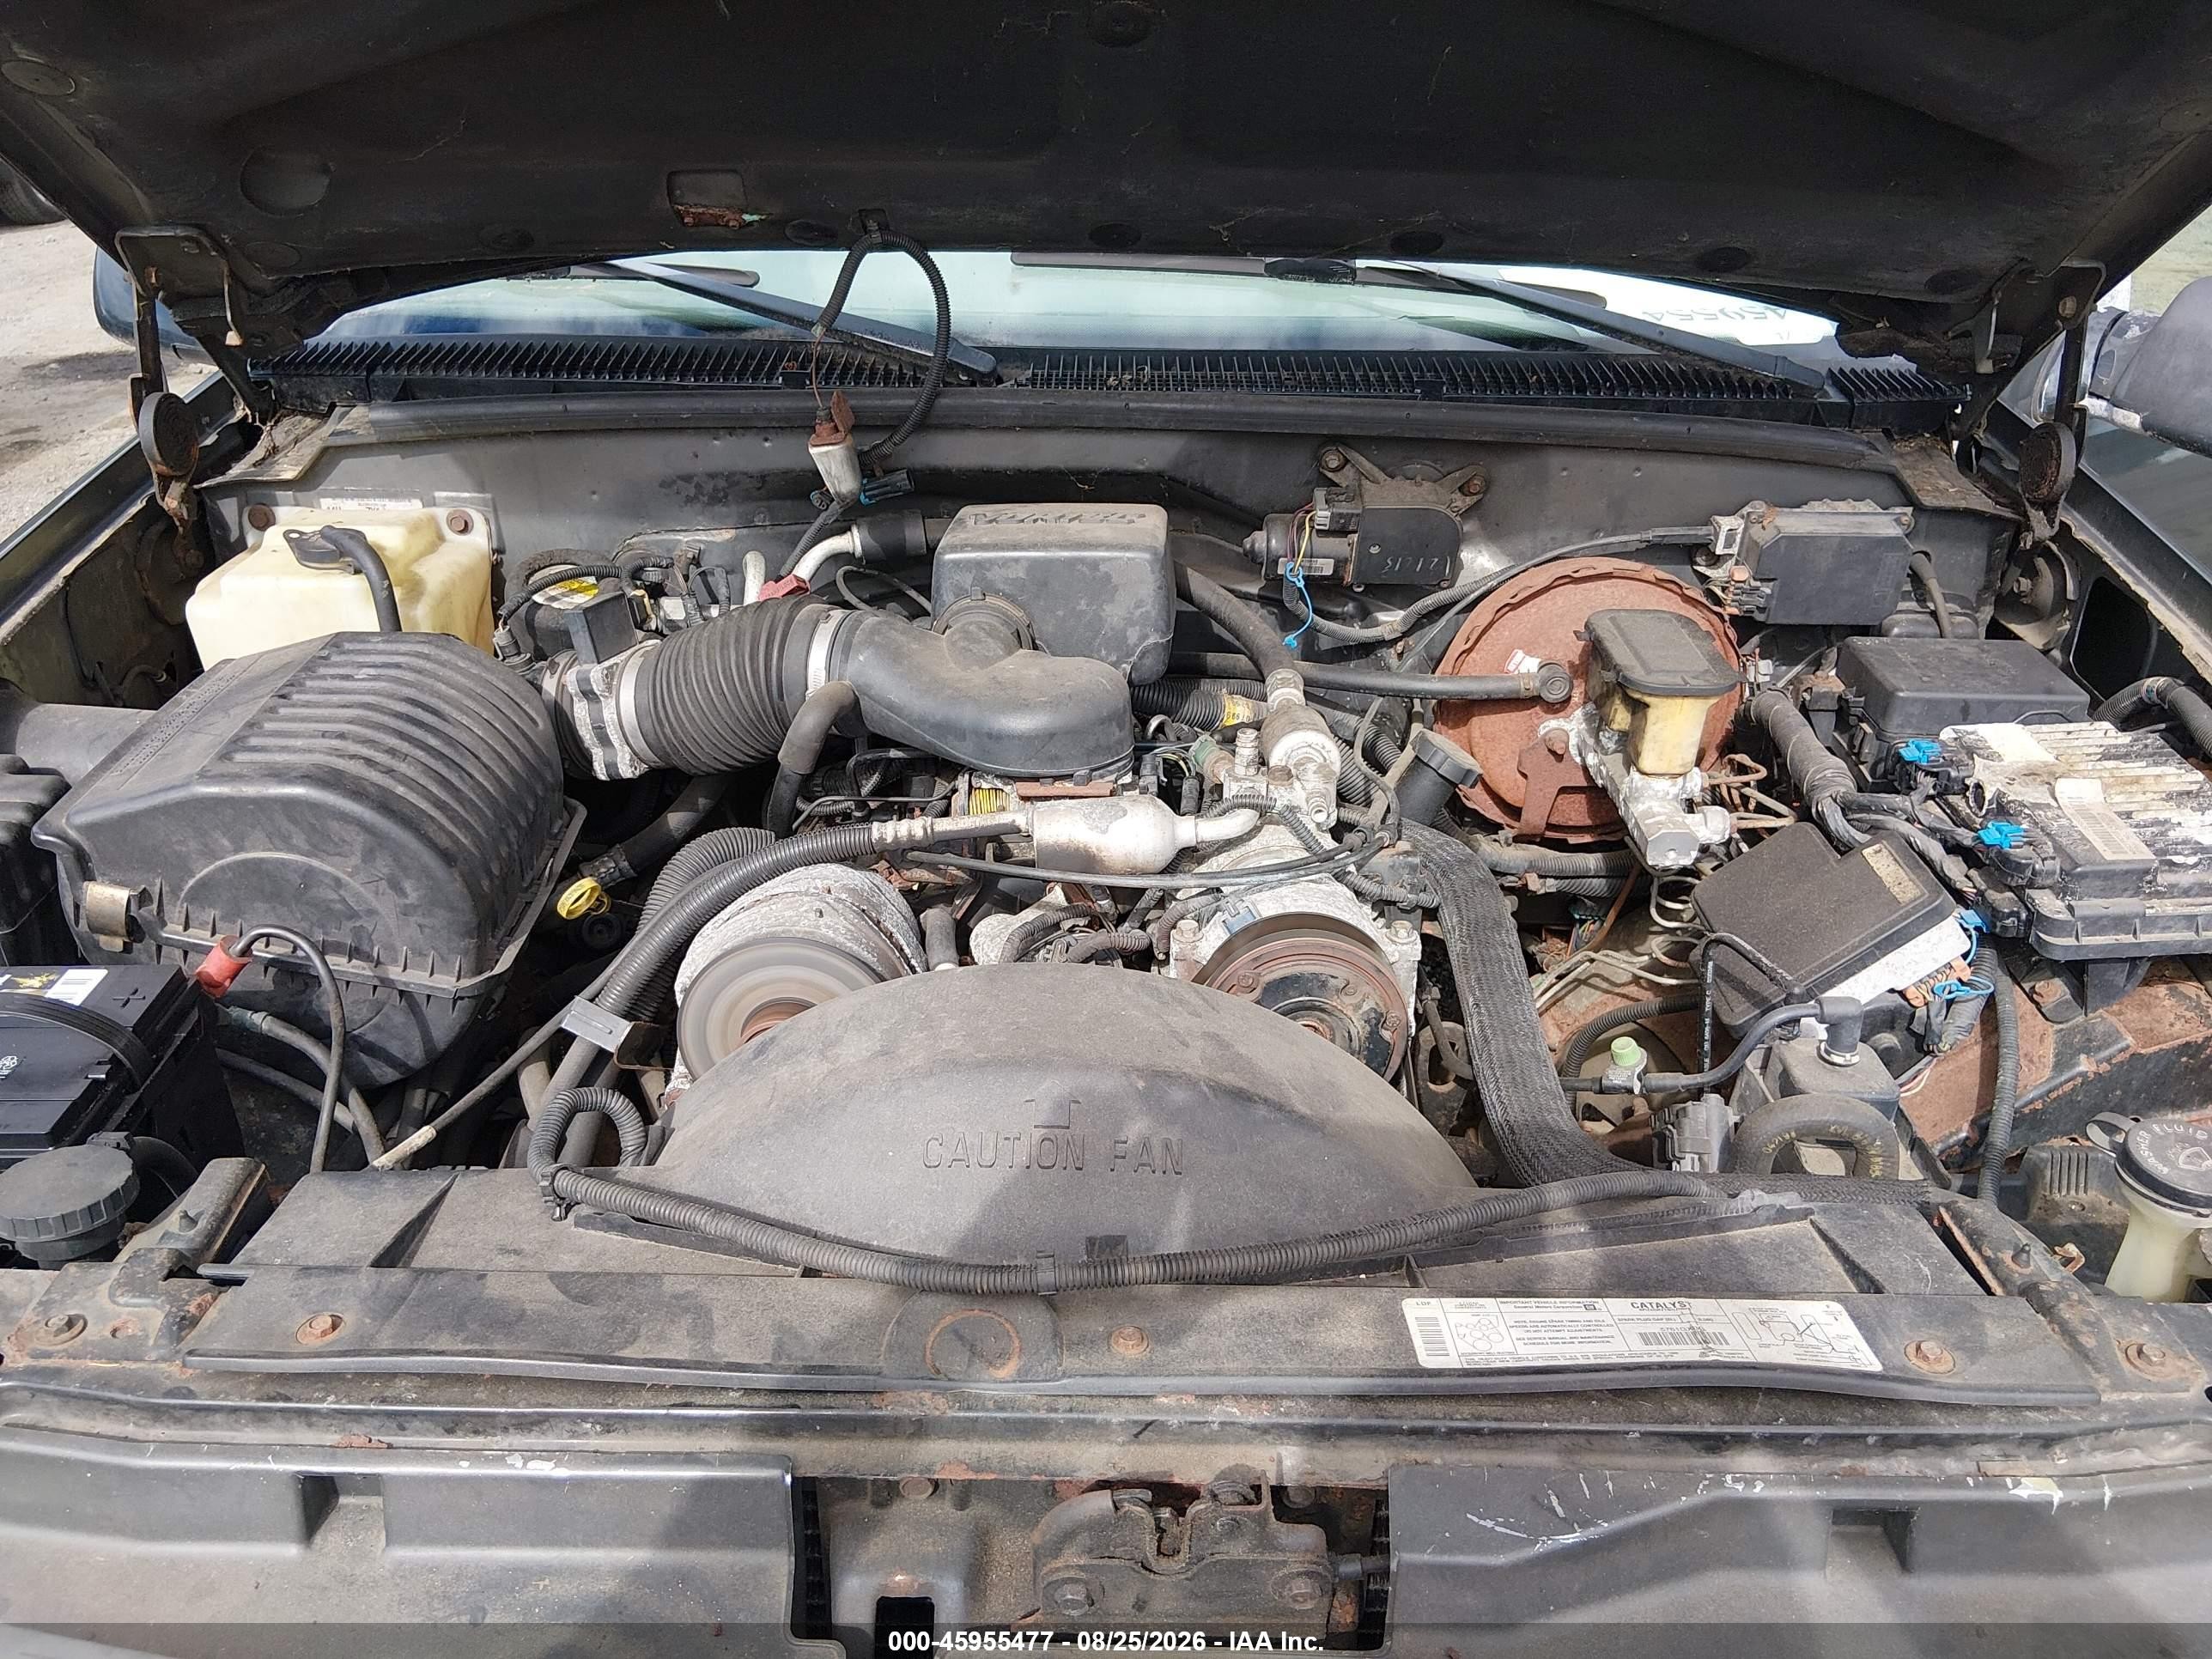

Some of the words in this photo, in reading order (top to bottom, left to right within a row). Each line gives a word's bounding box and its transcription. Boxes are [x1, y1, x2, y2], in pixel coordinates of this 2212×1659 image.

[922, 1131, 1085, 1171] CAUTION
[1109, 1135, 1183, 1176] FAN
[2136, 1130, 2169, 1175] WASHER
[2152, 1124, 2209, 1140] FLUID
